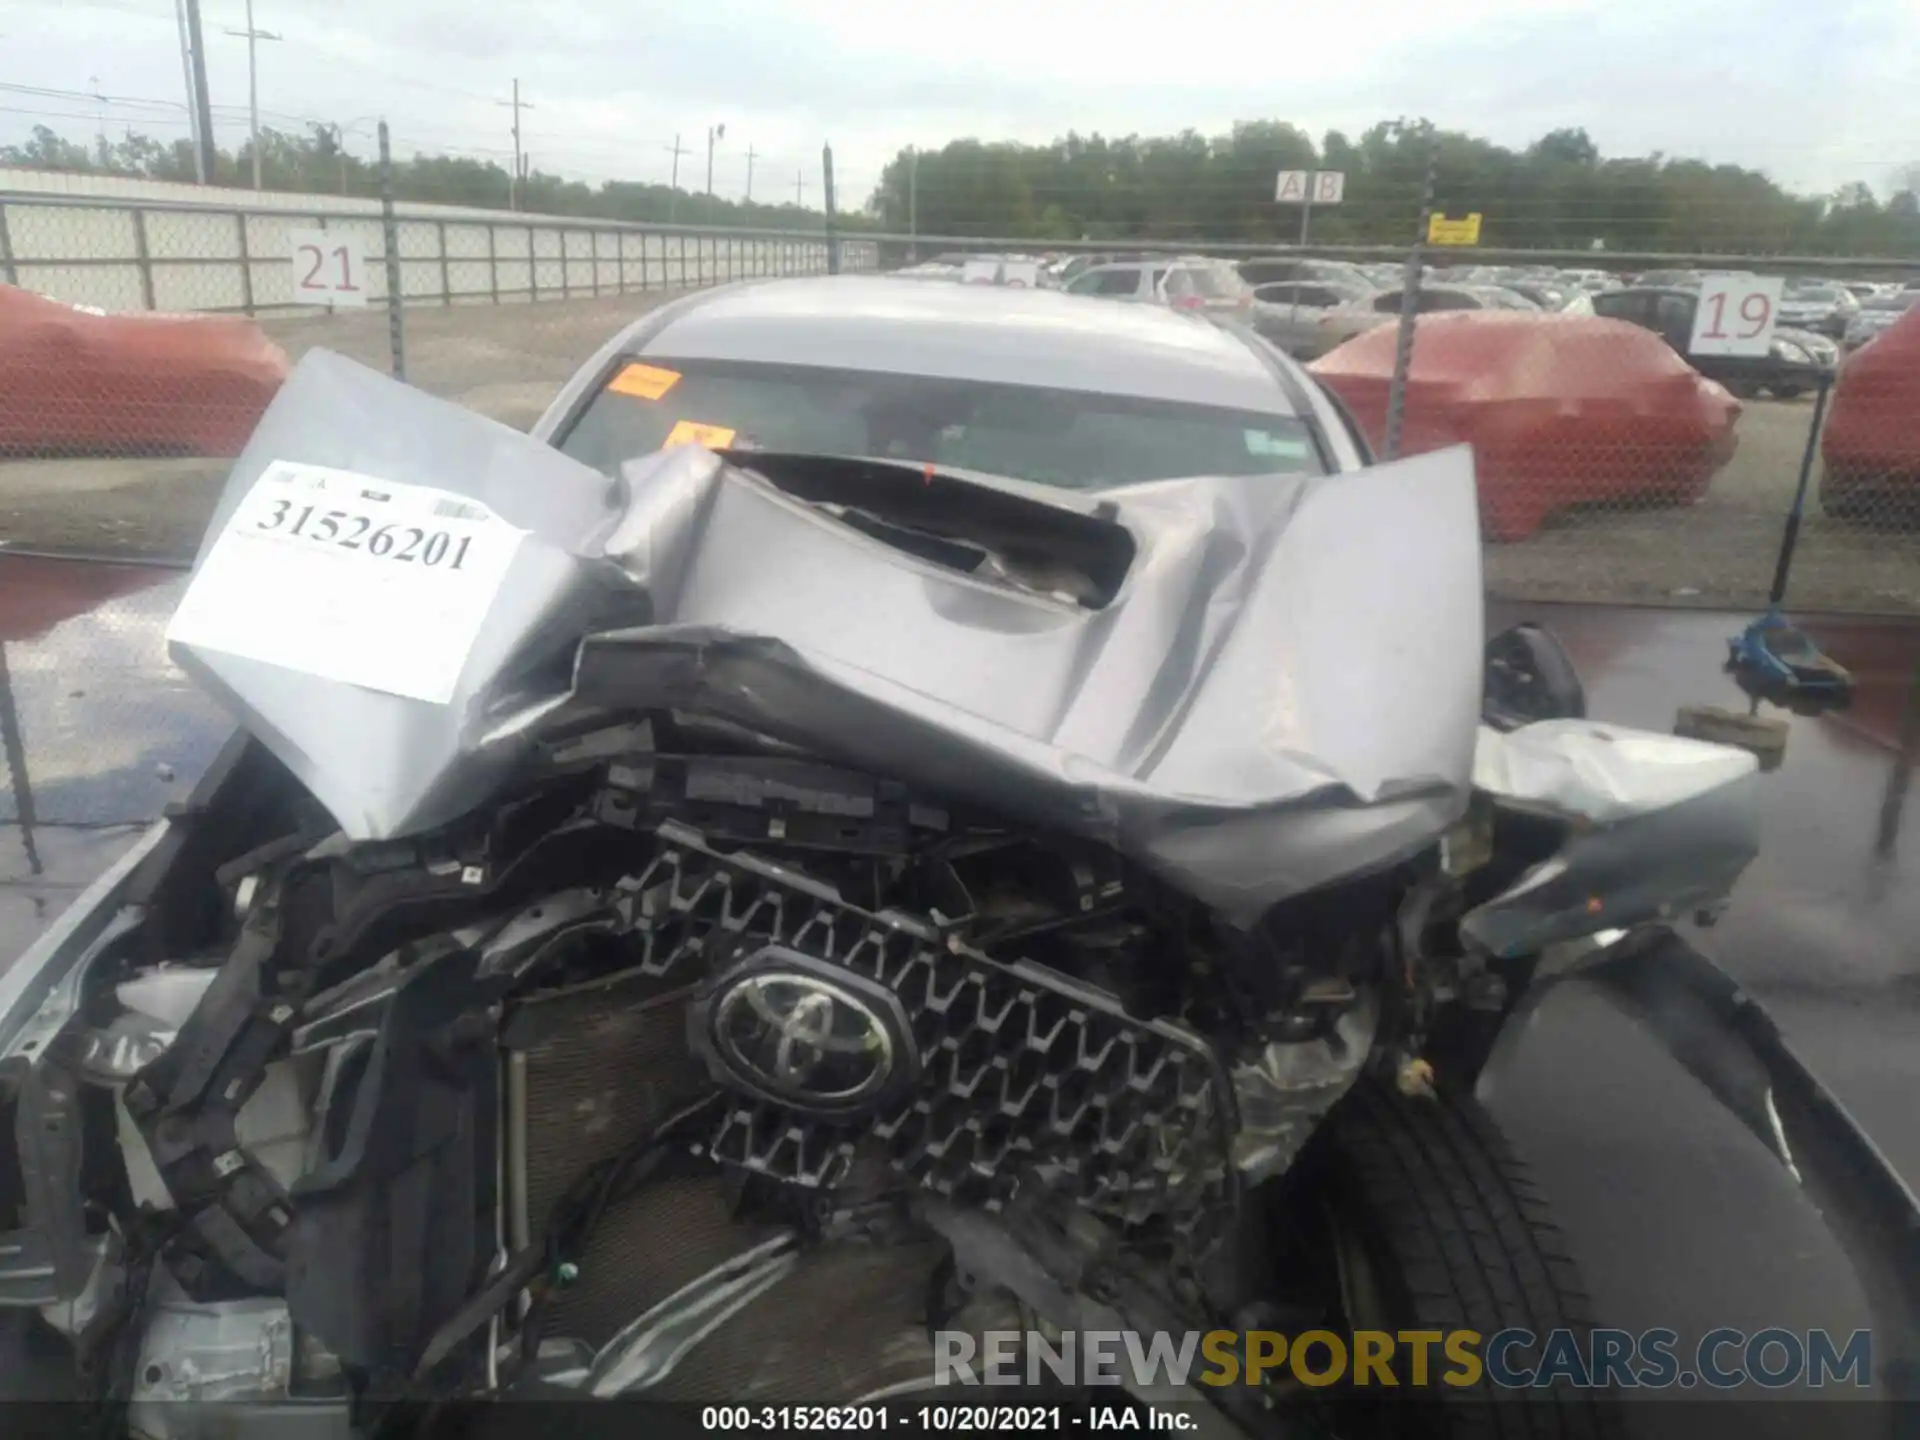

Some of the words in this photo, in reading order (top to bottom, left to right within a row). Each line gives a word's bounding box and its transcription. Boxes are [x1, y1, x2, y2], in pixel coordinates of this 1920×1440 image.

[1280, 173, 1301, 199] A
[1319, 174, 1337, 200] B
[298, 244, 361, 291] 21
[1700, 292, 1771, 340] 19
[257, 499, 473, 570] 31526201
